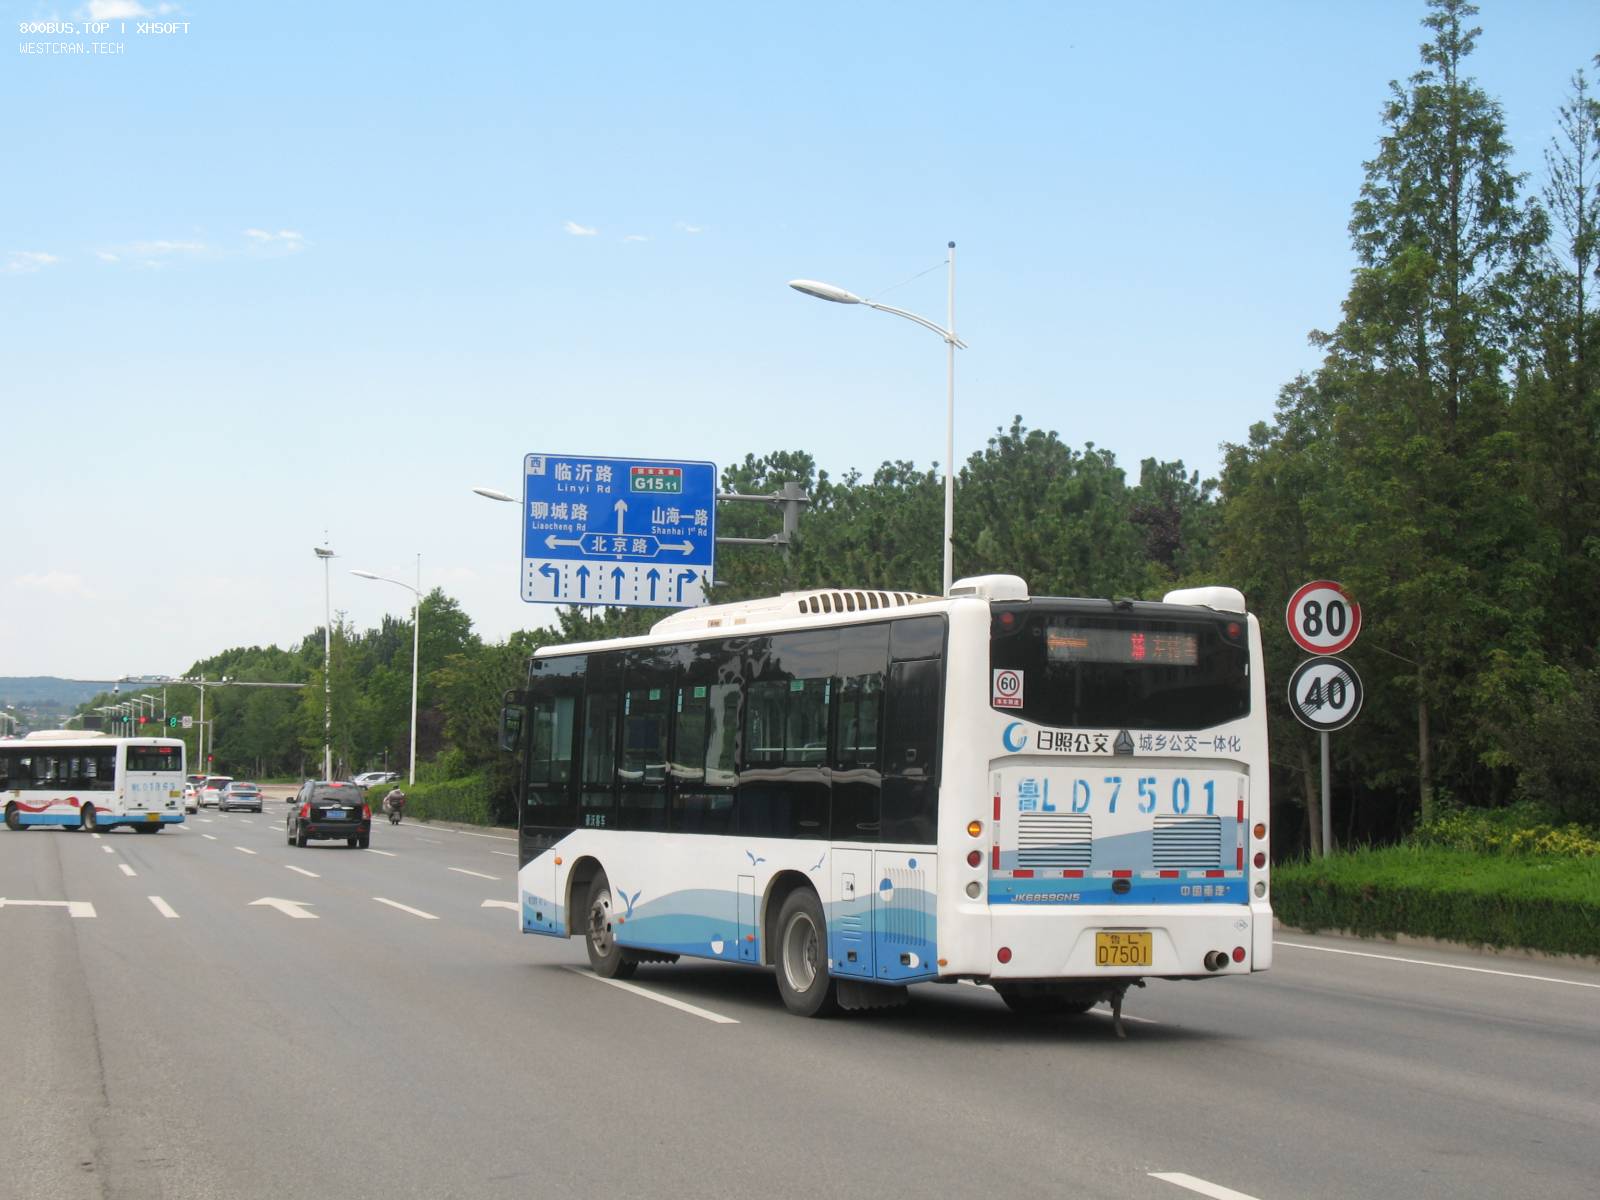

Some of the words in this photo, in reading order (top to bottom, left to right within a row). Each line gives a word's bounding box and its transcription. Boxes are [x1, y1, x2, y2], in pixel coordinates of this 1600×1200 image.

[530, 456, 541, 468] 西
[554, 462, 613, 483] 临沂路
[557, 483, 589, 495] Linyi
[597, 484, 611, 494] Rd
[530, 501, 588, 521] 聊城路
[651, 506, 708, 526] 山海一路
[532, 521, 573, 533] Liaocheng
[576, 522, 586, 532] Rd
[651, 526, 684, 536] Shanhai
[697, 528, 707, 537] Rd
[591, 536, 647, 554] 北京路
[1302, 600, 1347, 637] 80
[1000, 677, 1017, 691] 60
[1304, 676, 1347, 710] 40
[1037, 730, 1109, 754] 日照公交
[1138, 734, 1242, 754] 城乡公交一体化
[1098, 945, 1147, 964] D7501
